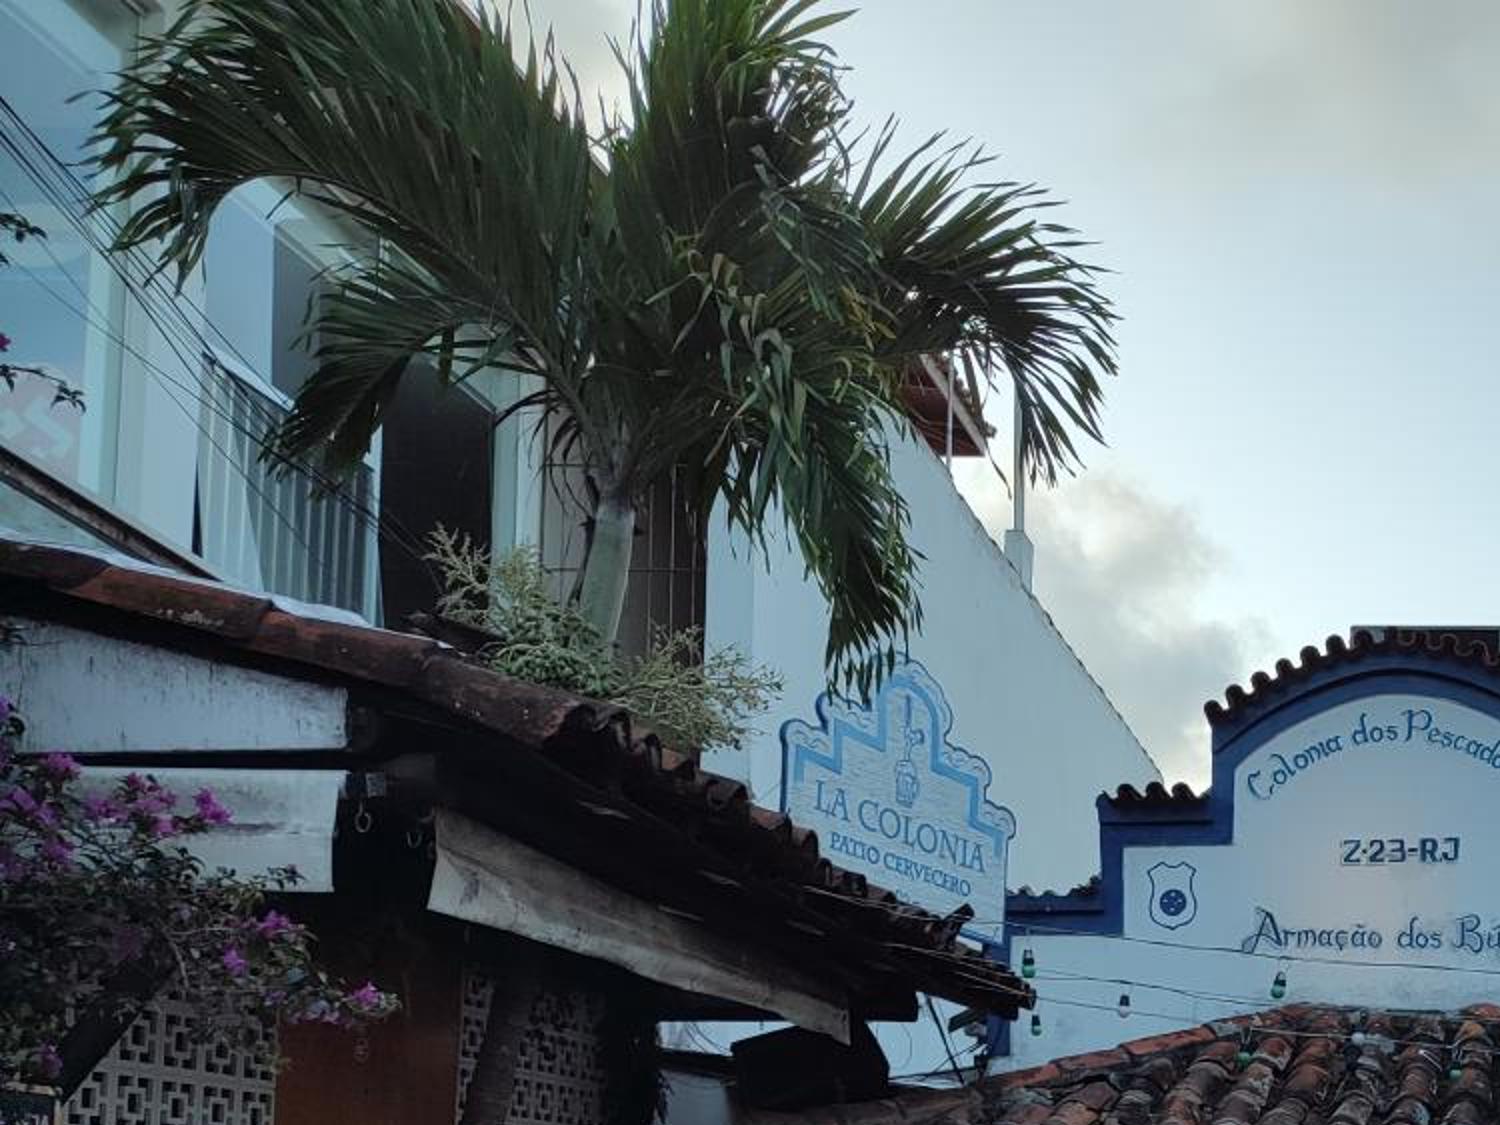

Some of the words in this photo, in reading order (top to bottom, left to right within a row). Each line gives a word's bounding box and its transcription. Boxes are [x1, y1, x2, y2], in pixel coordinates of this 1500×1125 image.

[1247, 735, 1343, 801] Colonia
[1352, 712, 1399, 747] dos
[813, 780, 850, 822] LA
[858, 799, 986, 873] COLONIA
[883, 853, 972, 898] CERVECERO
[1241, 906, 1384, 955] Armação
[1397, 917, 1443, 949] dos
